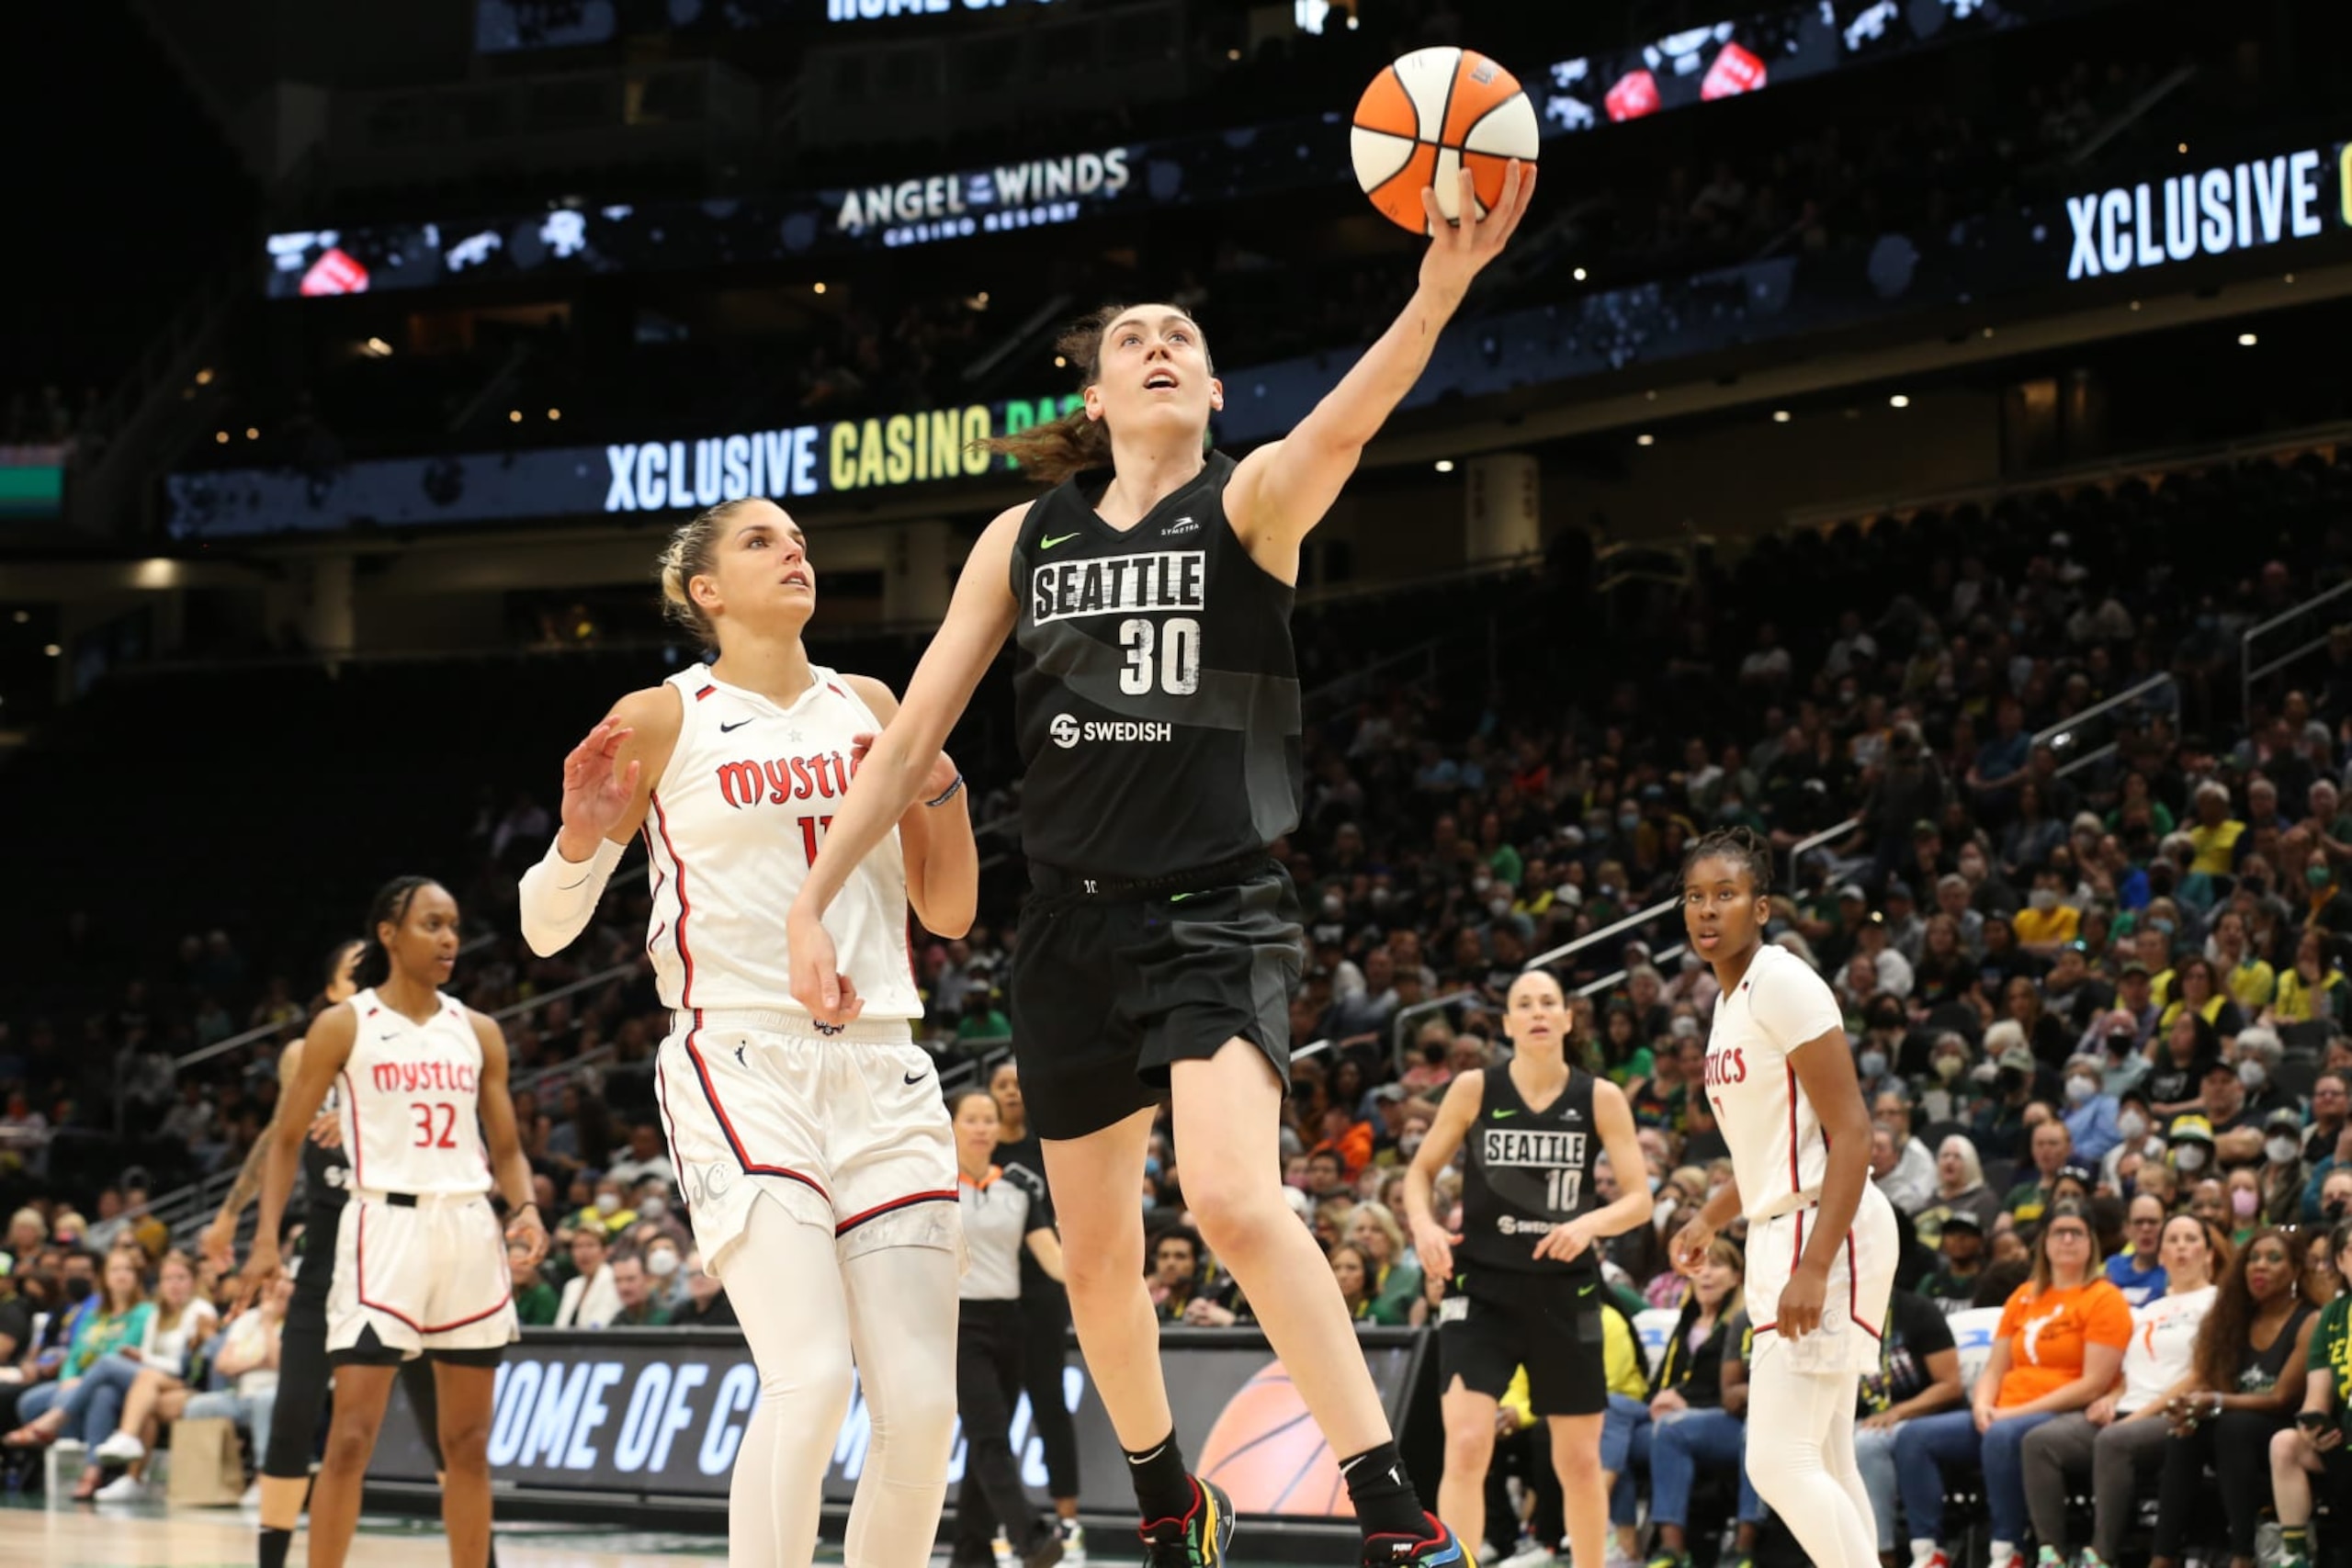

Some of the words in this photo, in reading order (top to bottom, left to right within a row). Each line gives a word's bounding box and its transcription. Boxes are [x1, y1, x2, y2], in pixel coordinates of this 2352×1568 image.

[837, 174, 966, 231] ANGEL
[994, 147, 1129, 205] WINDS
[2067, 149, 2322, 280] XCLUSIVE
[883, 217, 976, 247] CASINO
[605, 424, 818, 513] XCLUSIVE
[831, 404, 991, 490] CASINO
[1035, 555, 1202, 621] SEATTLE
[1119, 617, 1201, 695] 30
[1083, 721, 1172, 742] SWEDISH
[717, 750, 862, 810] mysti
[410, 1102, 457, 1149] 32
[1487, 1134, 1583, 1164] SEATTLE
[1546, 1168, 1582, 1212] 10
[613, 1361, 709, 1473] OF
